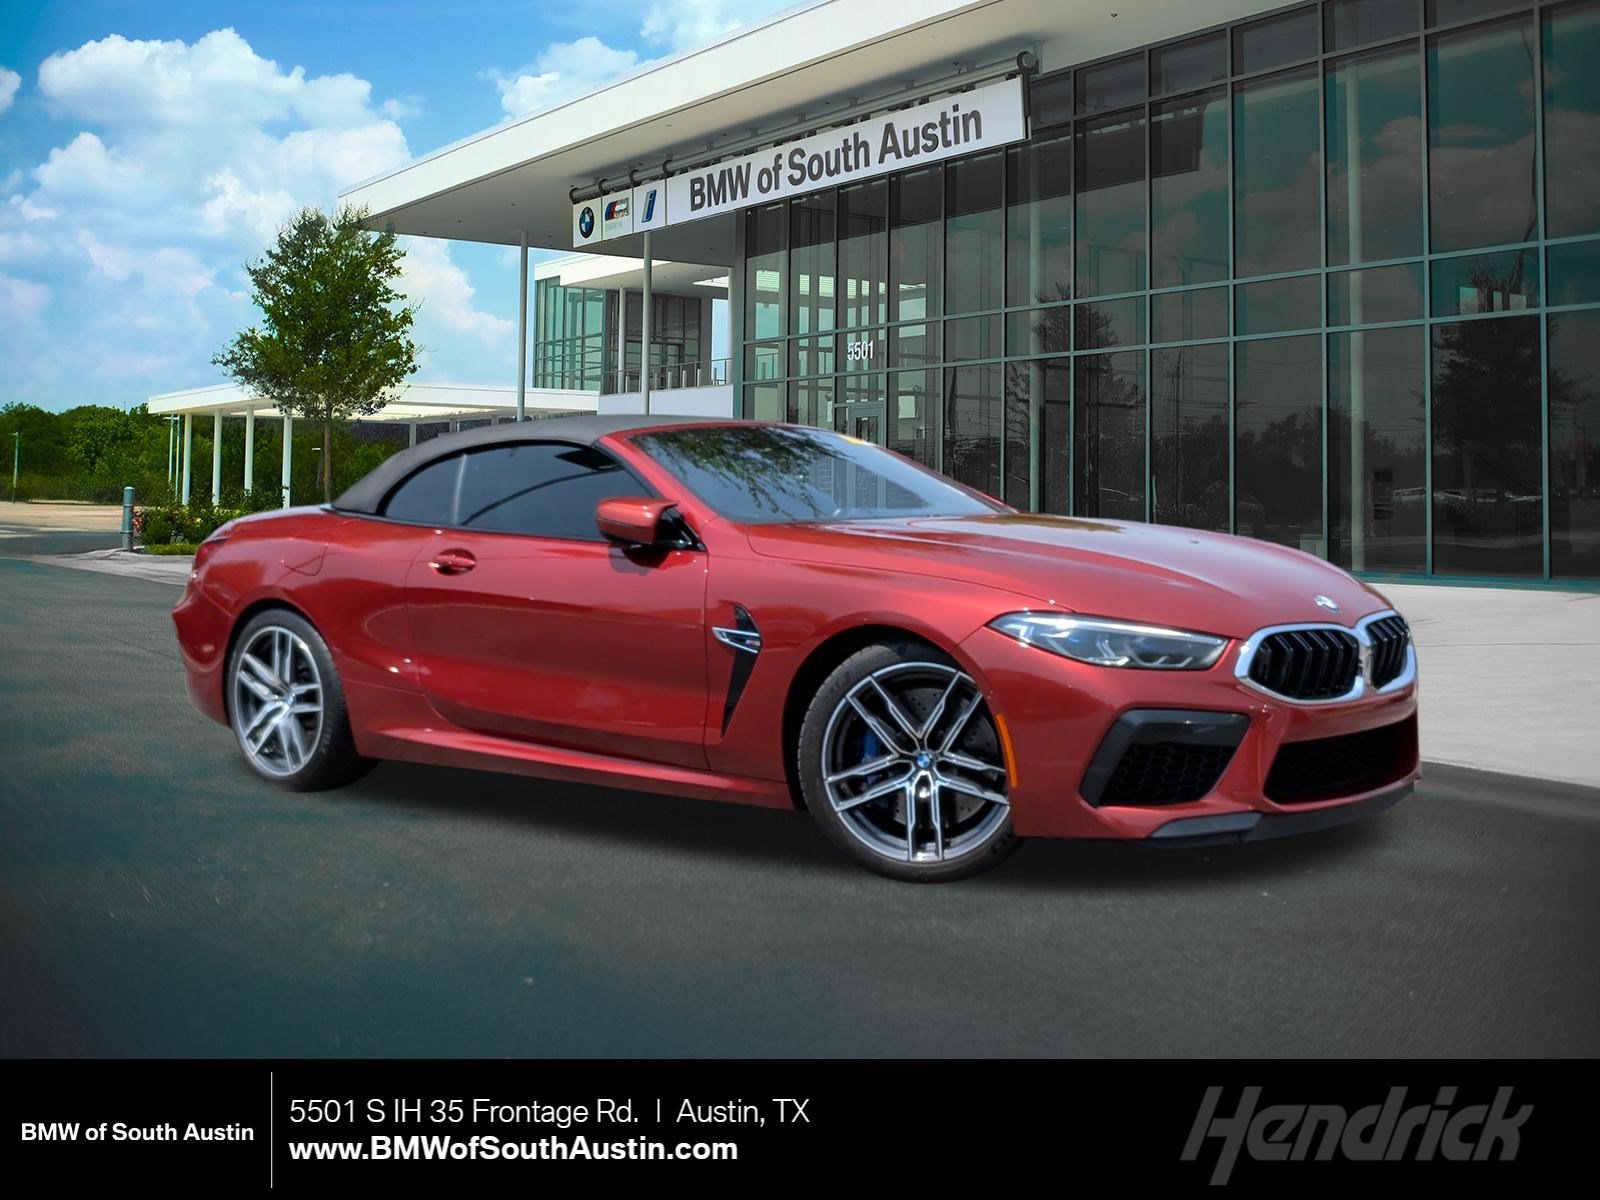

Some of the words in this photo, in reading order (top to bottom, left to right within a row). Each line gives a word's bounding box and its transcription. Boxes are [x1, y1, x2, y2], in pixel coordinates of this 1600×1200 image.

[690, 162, 752, 212] BMW
[757, 153, 783, 194] of
[787, 132, 871, 187] South
[878, 103, 983, 165] Austin
[847, 339, 874, 361] 5501
